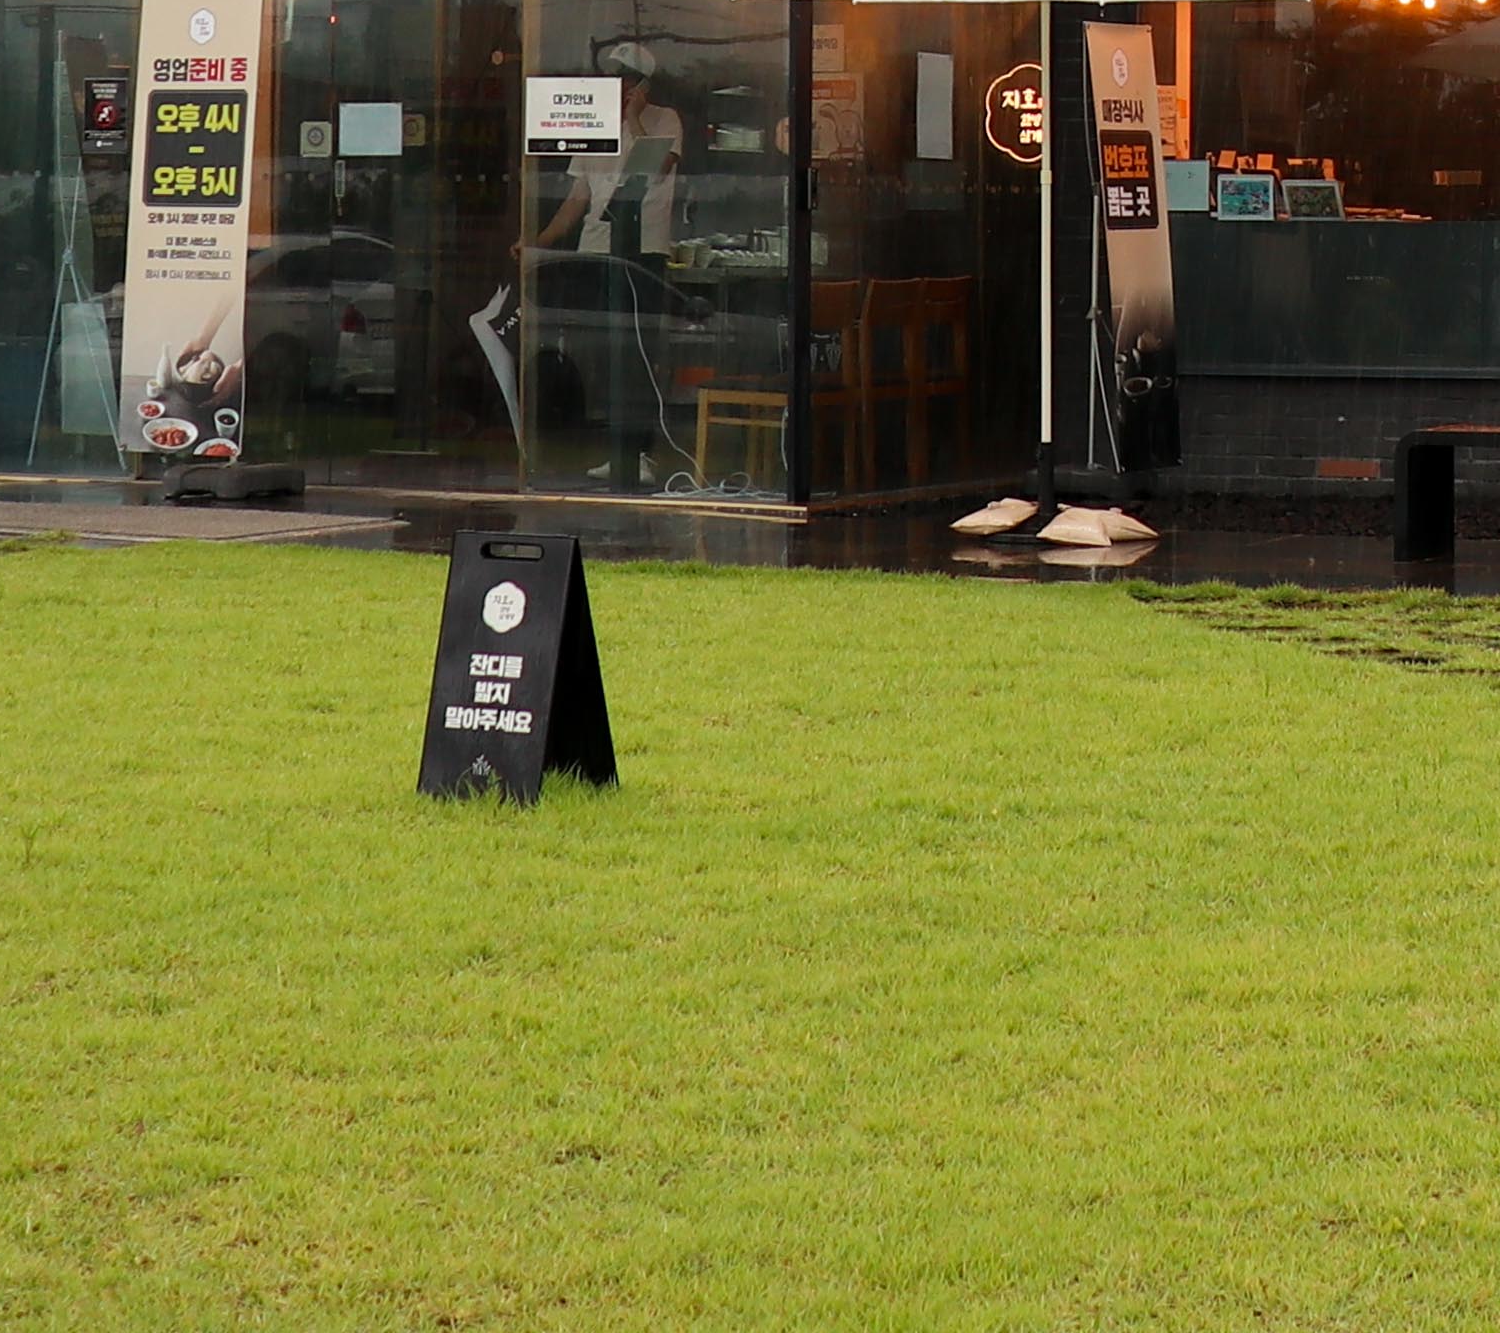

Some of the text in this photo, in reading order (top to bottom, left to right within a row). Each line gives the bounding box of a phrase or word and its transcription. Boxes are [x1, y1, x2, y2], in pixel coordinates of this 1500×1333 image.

[153, 57, 248, 83] 영업준비 중
[553, 94, 594, 105] 대기안내
[1002, 88, 1038, 109] 지호
[1102, 99, 1144, 123] 매장식사
[156, 103, 240, 133] 오후 4시
[1104, 144, 1150, 178] 번호표
[152, 166, 237, 196] 오후 5시
[1107, 186, 1151, 217] 뽑는 곳
[147, 213, 164, 224] 오후
[469, 653, 523, 679] 잔디를
[474, 681, 511, 705] 밟지
[444, 706, 532, 733] 말아주세요
